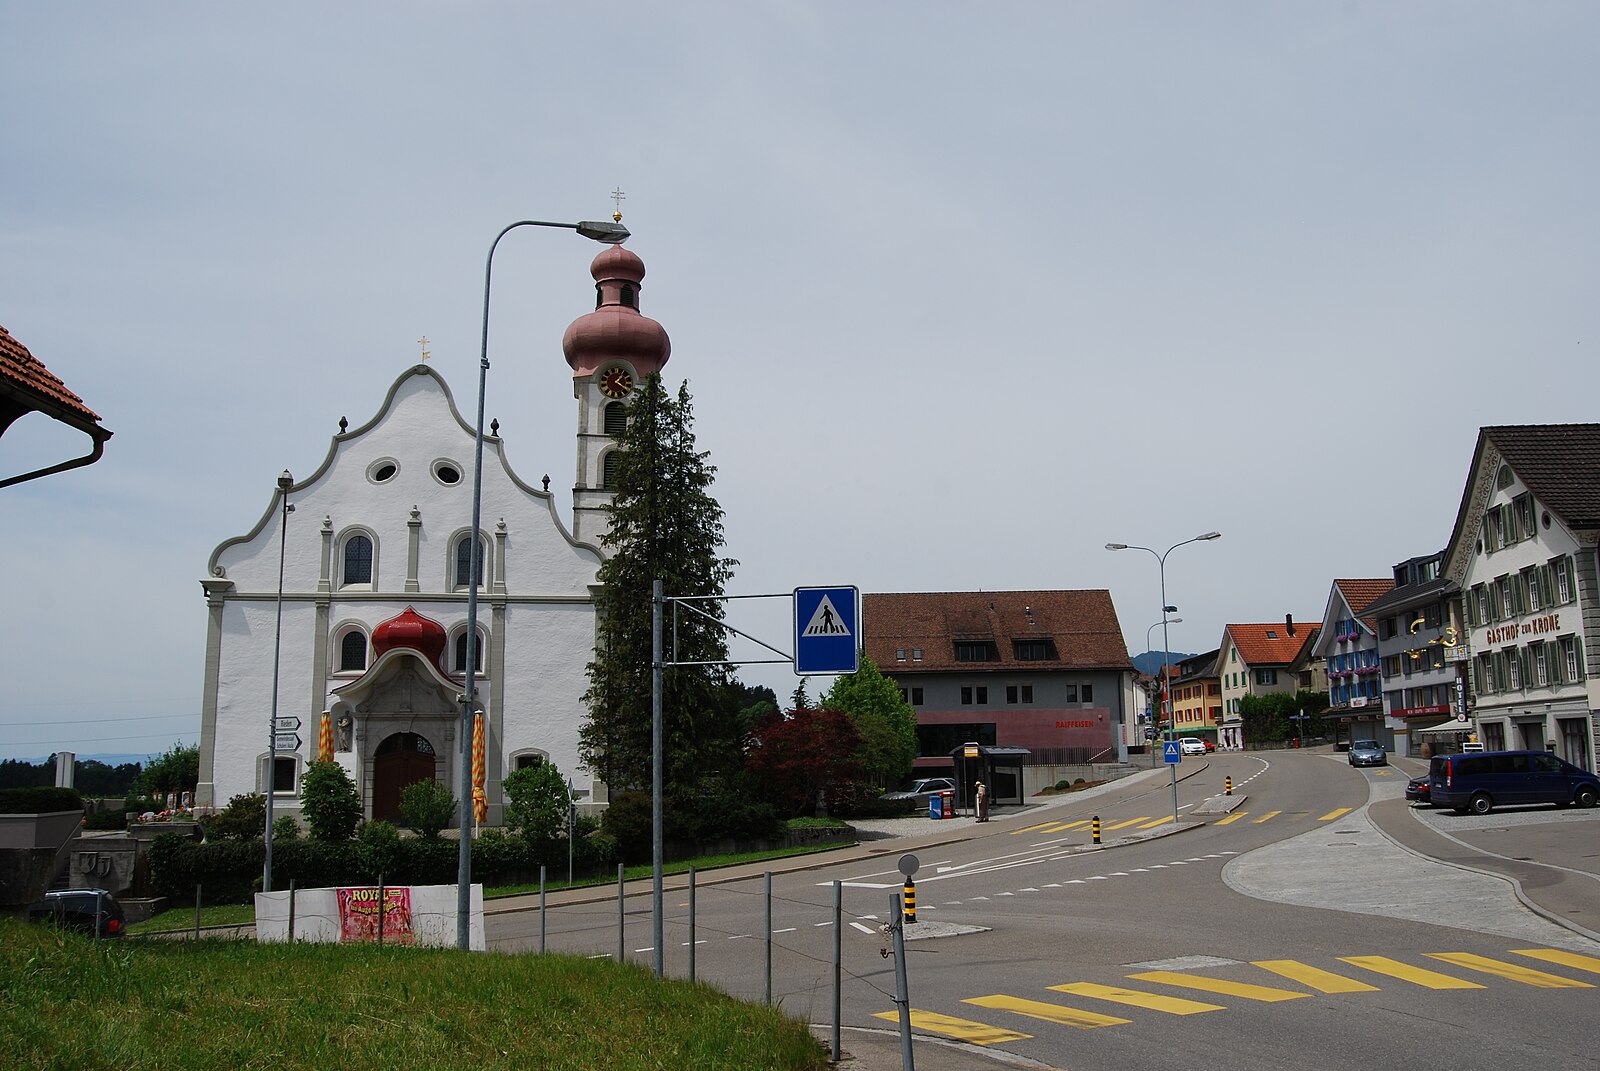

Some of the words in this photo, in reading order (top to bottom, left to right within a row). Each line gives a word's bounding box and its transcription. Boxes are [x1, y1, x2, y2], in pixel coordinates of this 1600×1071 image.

[1487, 623, 1519, 645] GASTHOF
[1532, 614, 1560, 635] KRONE
[1456, 677, 1464, 713] HOTEL
[1055, 720, 1094, 728] RAIFFEISEN
